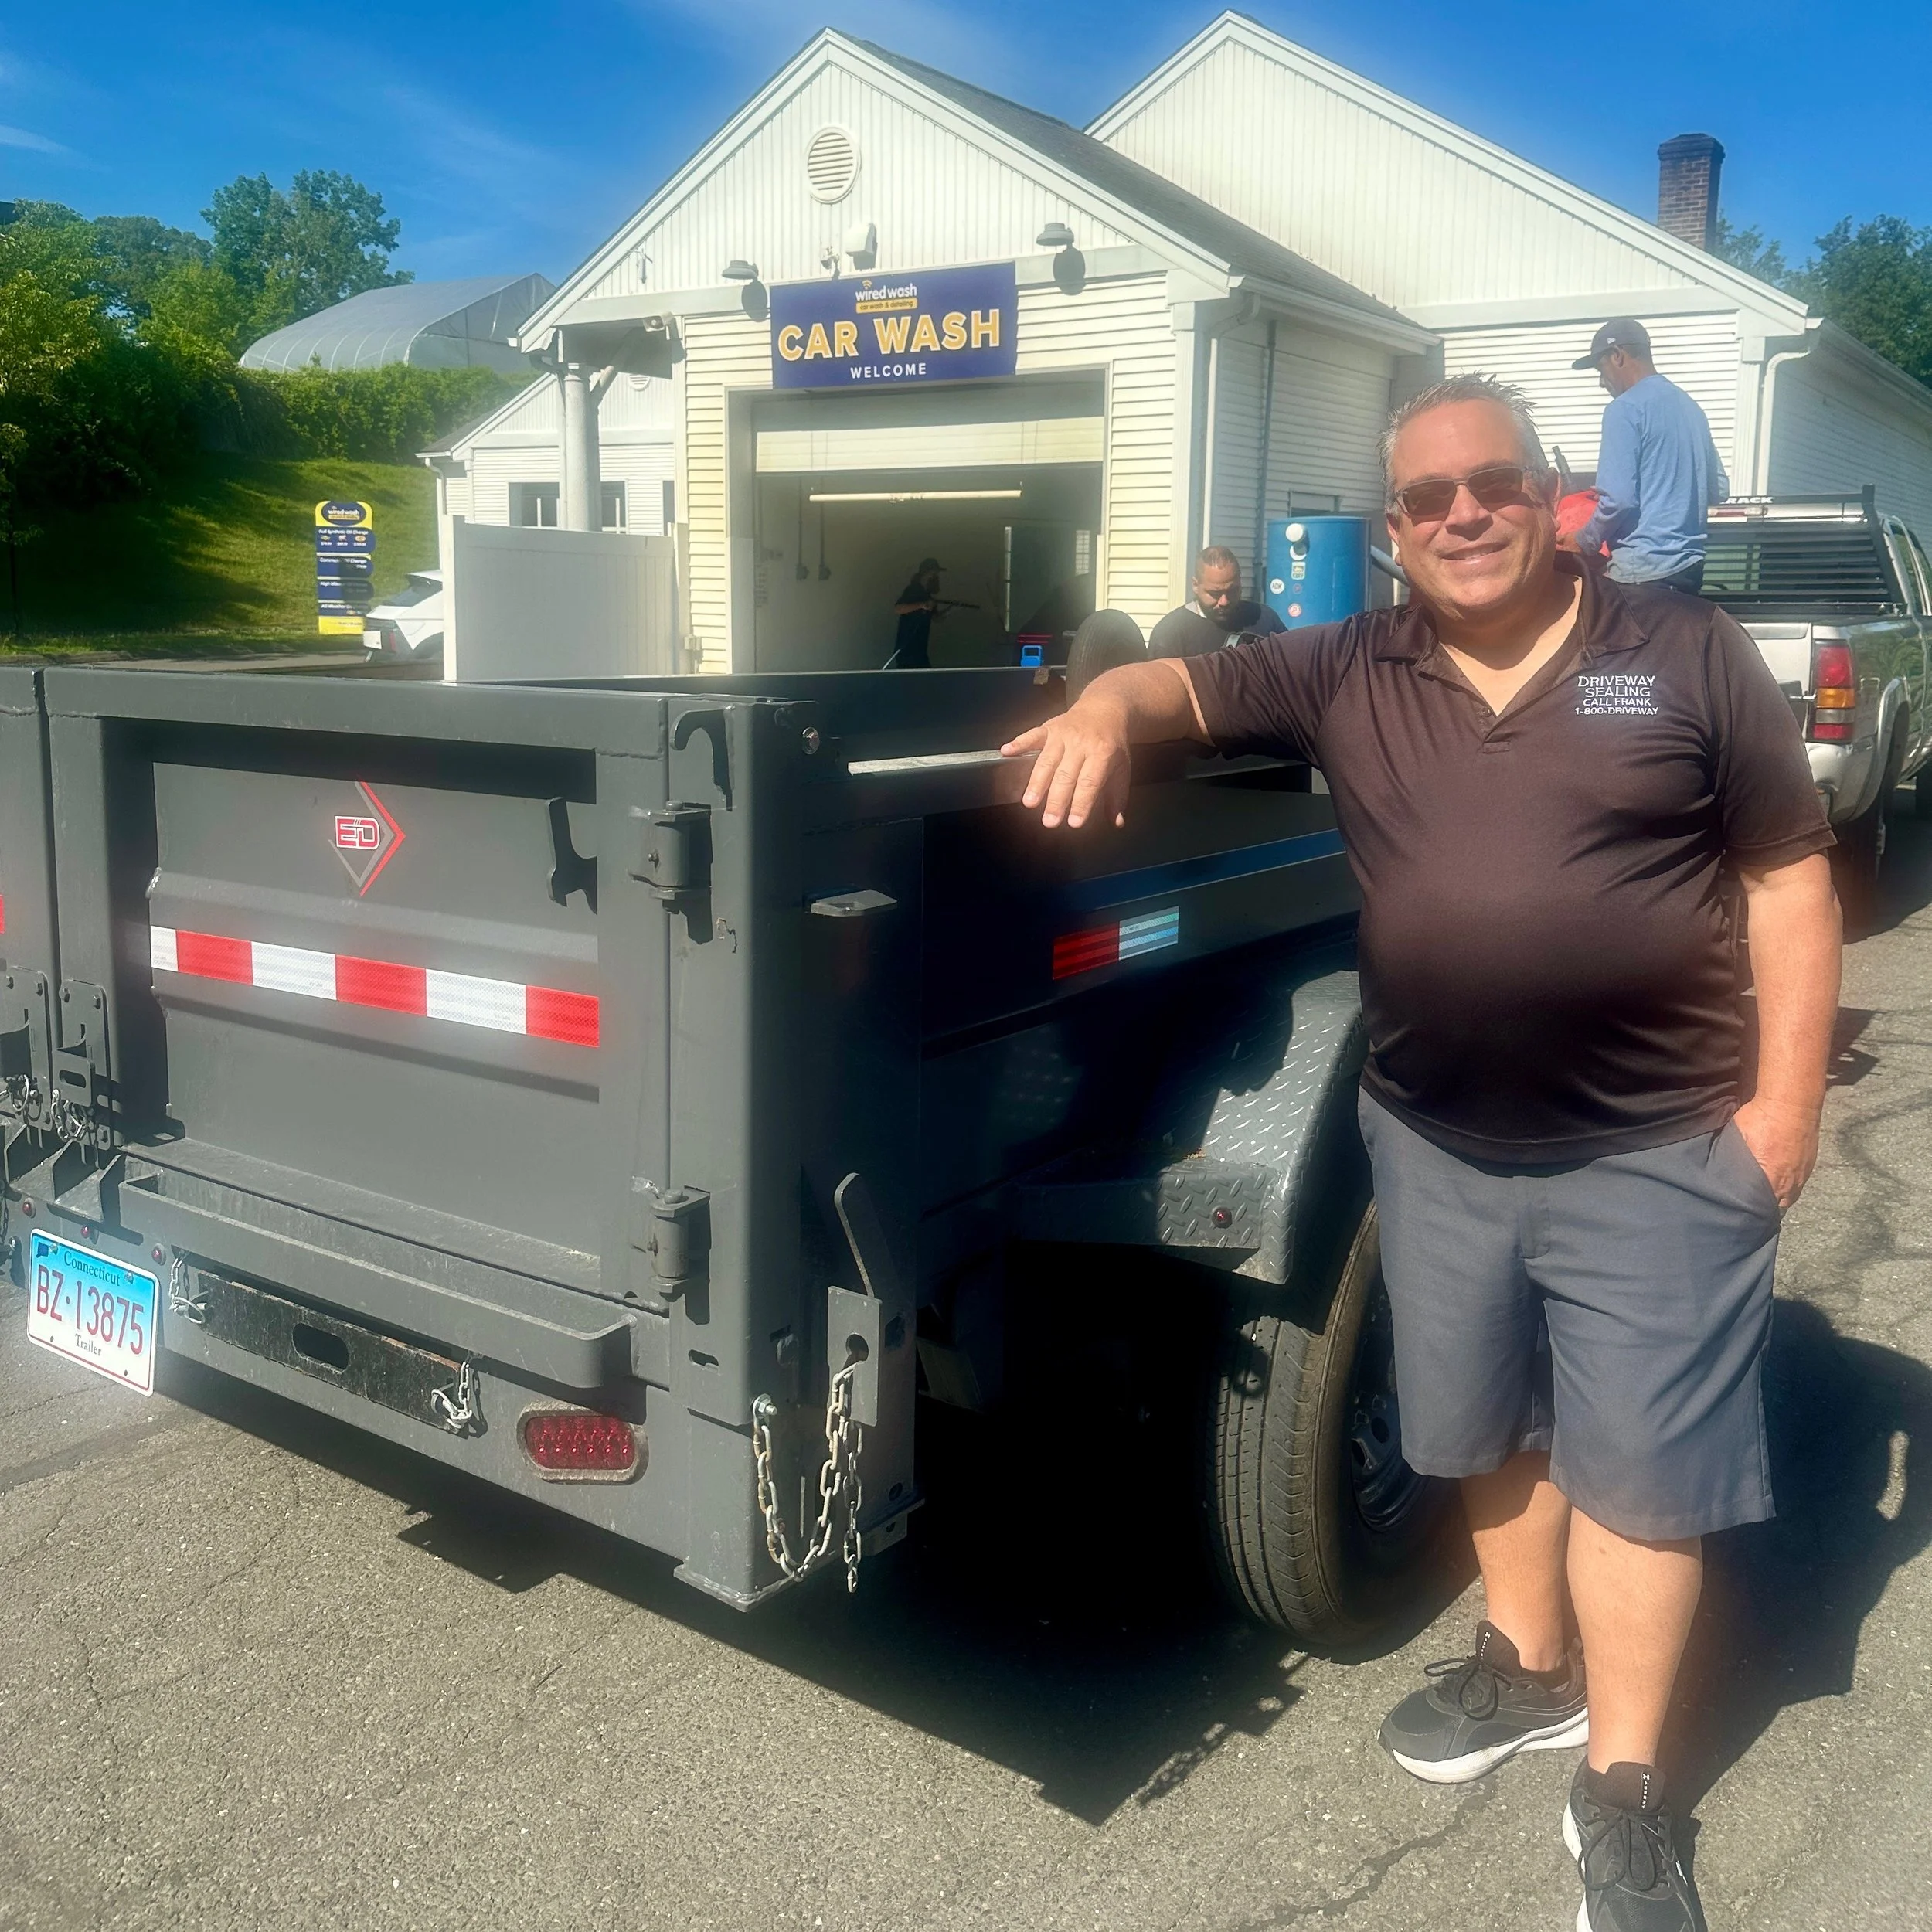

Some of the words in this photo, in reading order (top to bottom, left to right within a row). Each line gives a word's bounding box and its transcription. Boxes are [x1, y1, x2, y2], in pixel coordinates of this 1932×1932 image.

[855, 285, 886, 301] wired
[887, 283, 917, 298] wash
[778, 321, 859, 362] CAR
[873, 308, 1000, 355] WASH
[850, 362, 927, 379] WELCOME
[1577, 675, 1656, 687] DRIVEWAY
[1585, 685, 1651, 697] SEALING
[1583, 697, 1612, 706] CALL
[1614, 697, 1651, 706] FRANK
[1574, 706, 1659, 716] 1-800-DRIVEWAY
[63, 1250, 121, 1287] Connecticut
[75, 1333, 102, 1357] Trailer
